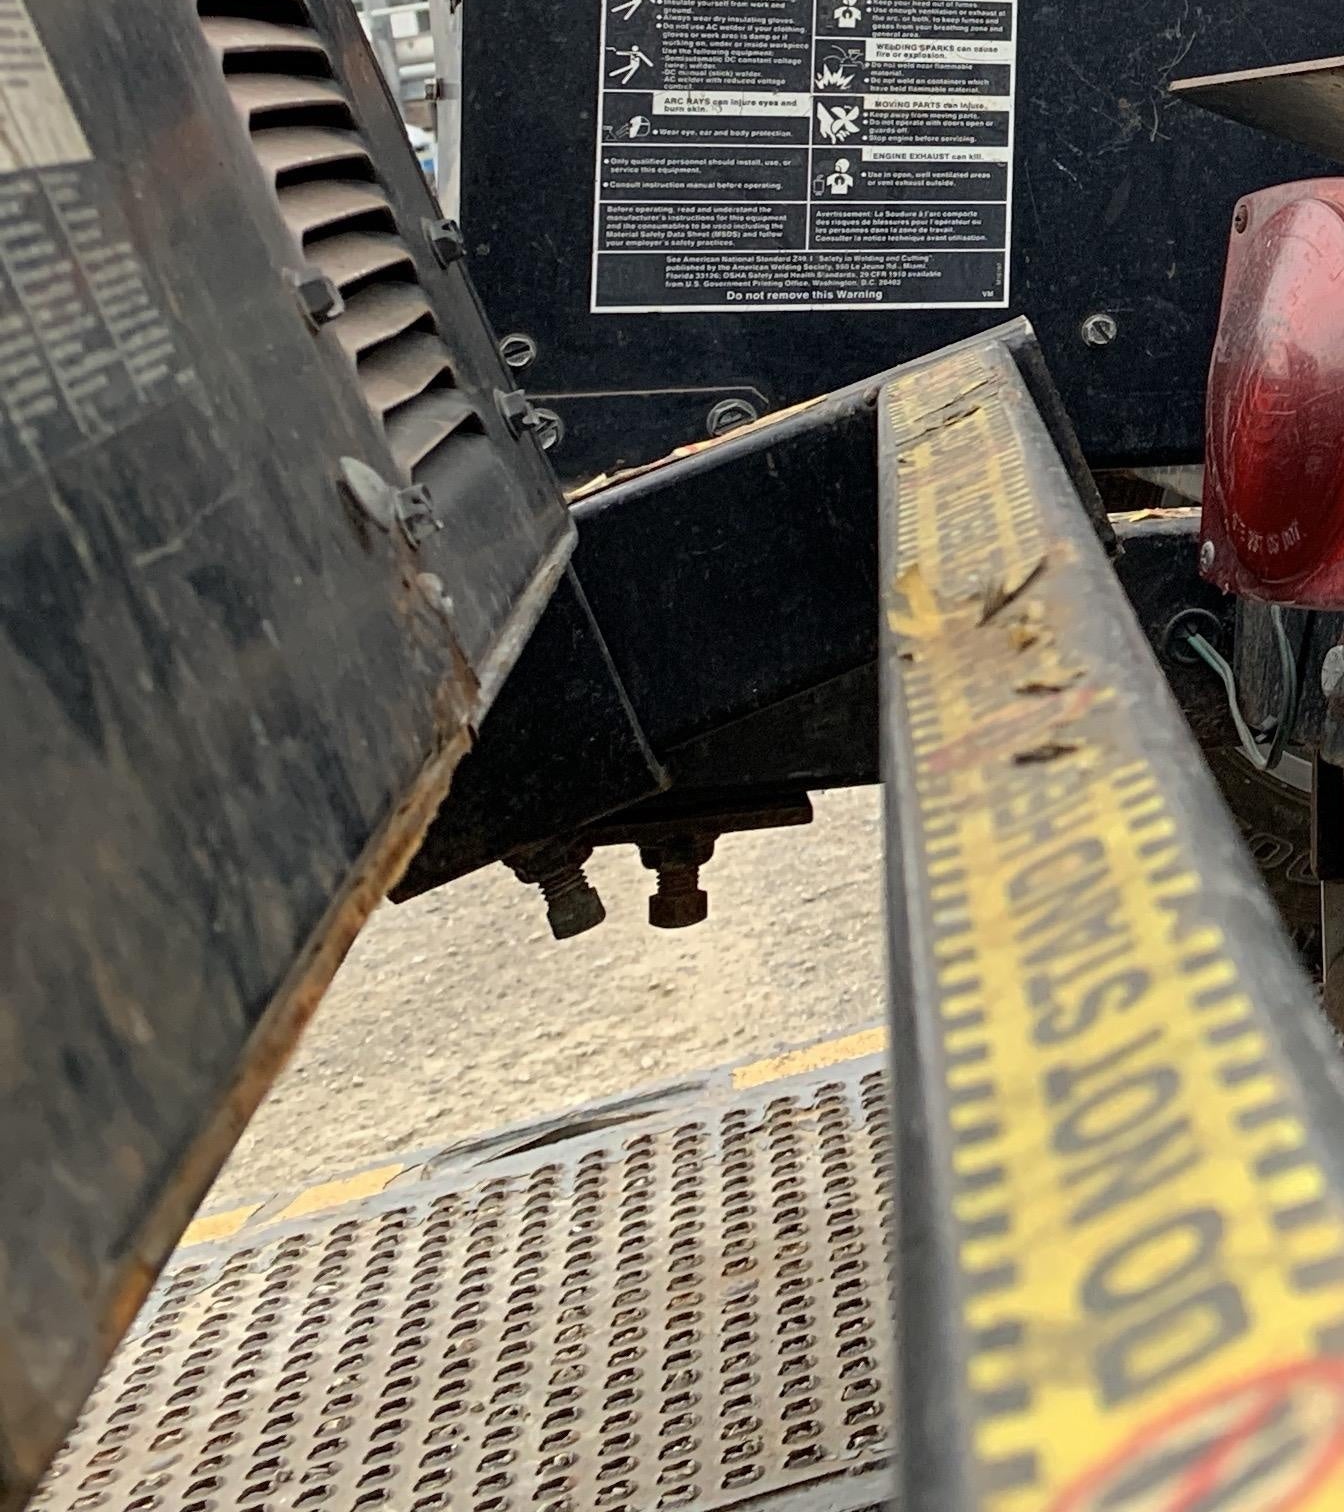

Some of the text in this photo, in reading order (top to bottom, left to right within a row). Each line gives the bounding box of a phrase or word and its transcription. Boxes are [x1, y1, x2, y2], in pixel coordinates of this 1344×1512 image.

[876, 43, 917, 51] WELDING
[918, 44, 955, 52] SPARKS
[876, 50, 890, 58] fire
[685, 97, 711, 105] RAYS
[729, 98, 756, 107] injure
[757, 100, 779, 108] eyes
[875, 100, 910, 108] MOVING
[664, 105, 685, 113] burn
[872, 152, 907, 160] ENGINE
[908, 152, 950, 160] EXHAUST
[726, 290, 743, 299] Do
[744, 290, 764, 299] not
[811, 290, 834, 299] this
[835, 289, 883, 300] Warning
[1006, 836, 1154, 1046] STAND
[1042, 1028, 1202, 1228] NOT
[1076, 1204, 1252, 1410] DO
